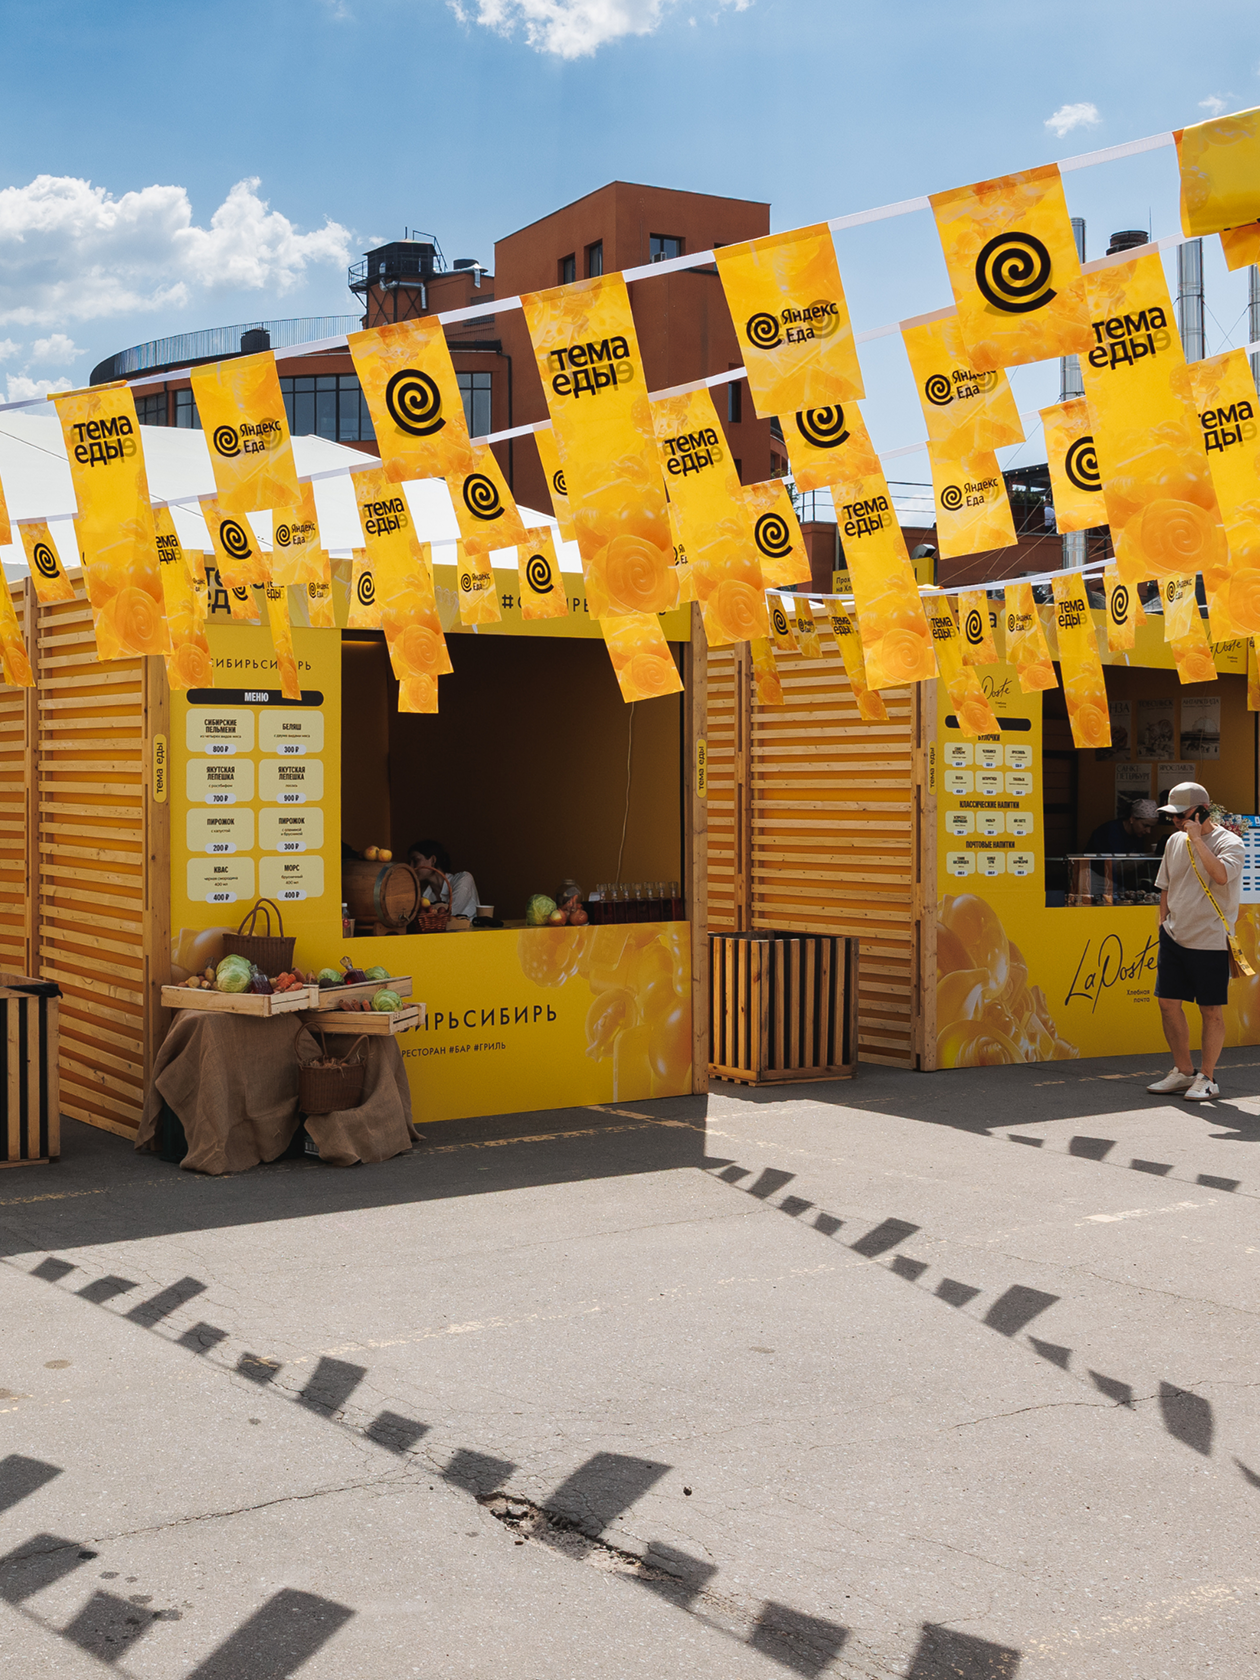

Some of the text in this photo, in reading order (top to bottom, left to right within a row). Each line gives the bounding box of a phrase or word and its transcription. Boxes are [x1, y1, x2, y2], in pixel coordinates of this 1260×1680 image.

[781, 301, 839, 324] Яндекс
[1092, 307, 1167, 343] тема
[786, 325, 815, 344] Еда
[550, 335, 631, 371] тема
[1088, 333, 1156, 370] еды
[552, 363, 618, 399] еды
[956, 384, 980, 399] Еда
[1199, 401, 1254, 430] ема
[74, 415, 133, 442] тема
[240, 419, 281, 438] Яндекс
[243, 439, 265, 454] Еда
[664, 427, 720, 457] тема
[1204, 424, 1243, 455] ды
[74, 440, 125, 467] еды
[666, 448, 714, 477] еды
[964, 477, 999, 494] Яндекс
[364, 497, 405, 519] тема
[843, 495, 889, 519] тема
[966, 495, 985, 507] Еда
[291, 523, 316, 533] Яндекс
[365, 516, 400, 536] еды
[844, 514, 883, 538] еды
[156, 534, 178, 549] ема
[293, 535, 305, 545] Еда
[159, 549, 177, 565] ды
[472, 571, 491, 582] Яндекс
[836, 576, 850, 584] Прох
[267, 589, 281, 600] еды
[1058, 599, 1085, 614] тема
[831, 616, 851, 625] тема
[931, 617, 953, 628] тема
[1058, 612, 1081, 629] еды
[933, 628, 952, 641] еды
[210, 658, 312, 671] ИБИРЬСИРЬ
[244, 692, 269, 702] МЕНЮ
[1109, 702, 1130, 714] НЗА
[282, 723, 302, 731] БЕЛЯШ
[157, 742, 165, 764] еды
[212, 745, 224, 753] 800
[207, 773, 234, 781] ЛЕПЕШКА
[279, 773, 305, 781] ЛЕПЕШКА
[959, 801, 1020, 809] КЛАССИЧЕСКИЕ НАПИТКИ
[966, 841, 993, 849] ПОЧТОВЫЕ
[213, 893, 225, 901] 400
[399, 1004, 557, 1033] ИРЬСИБИРЬ
[449, 1044, 471, 1054] #БАР
[473, 1041, 506, 1052] #ГРИЛЬ
